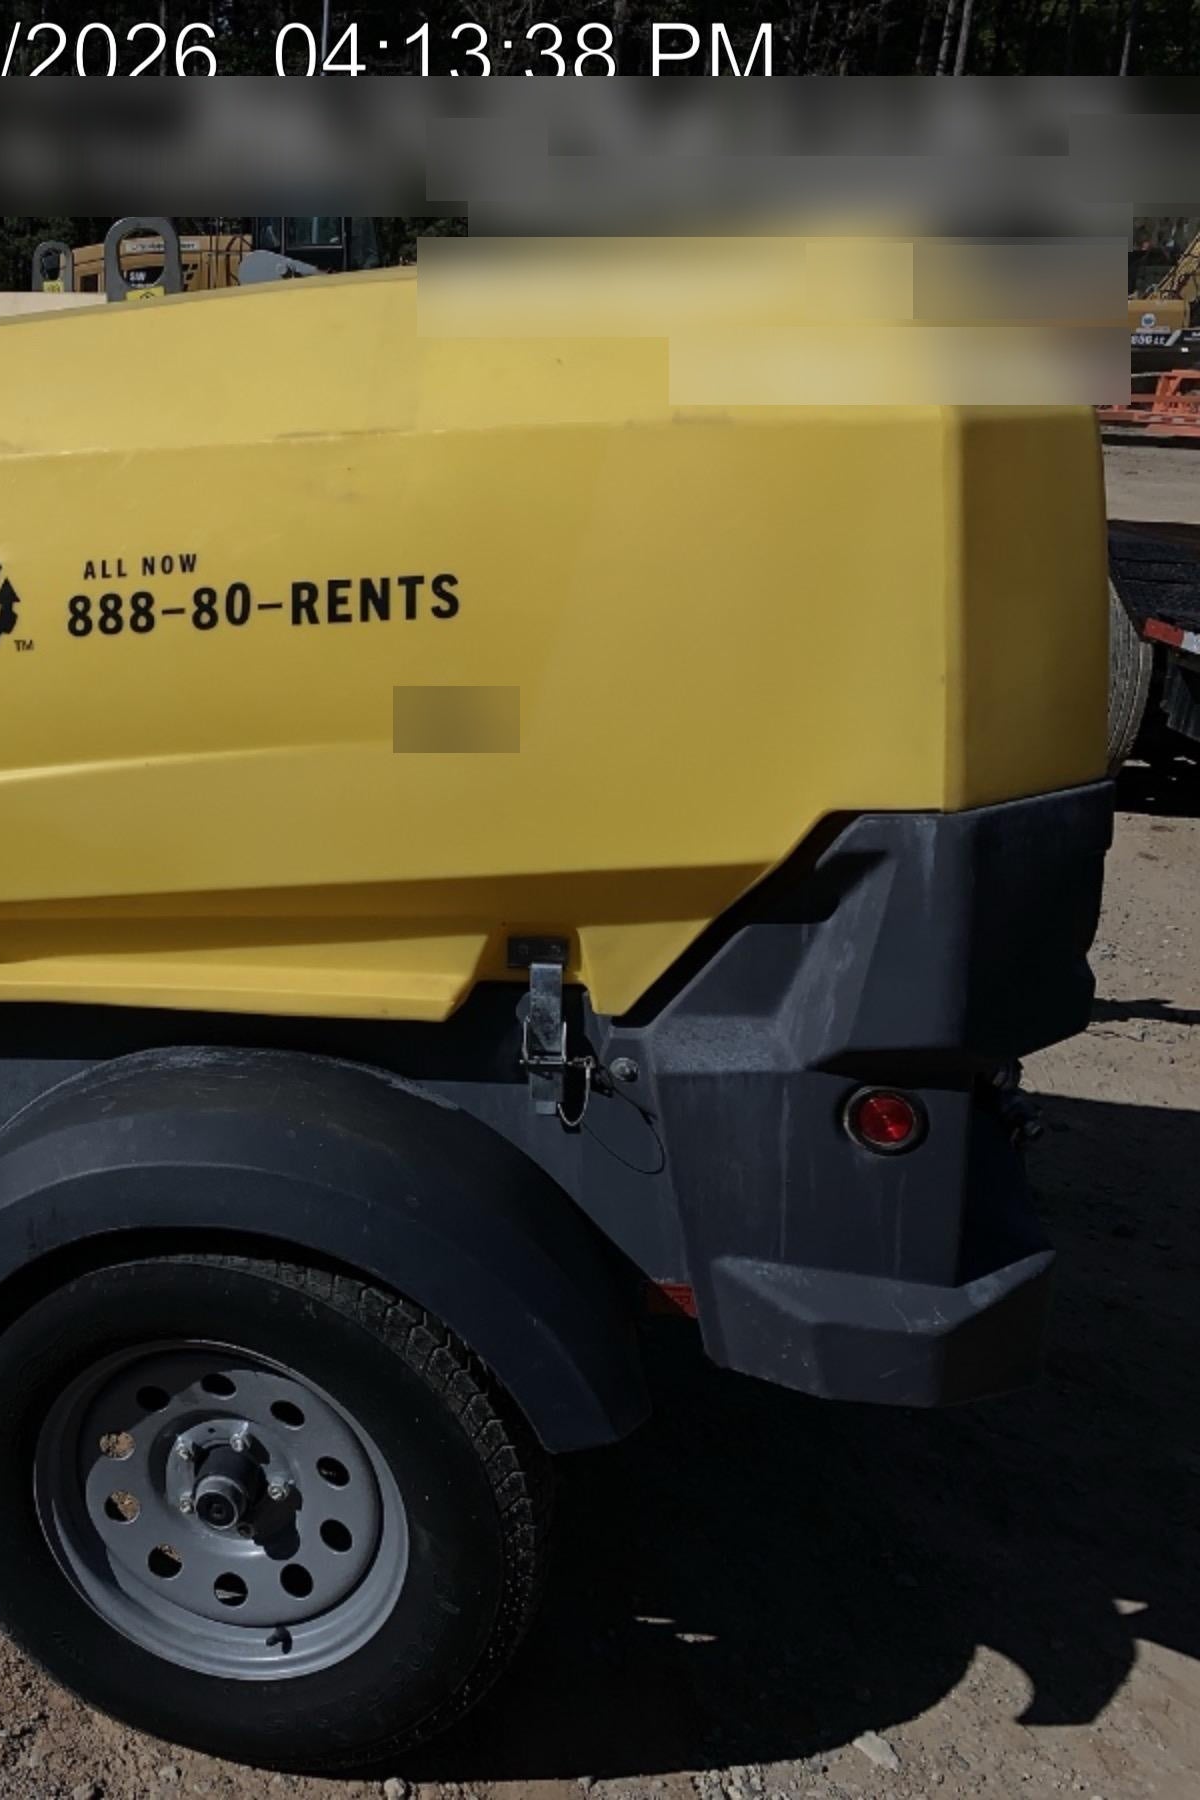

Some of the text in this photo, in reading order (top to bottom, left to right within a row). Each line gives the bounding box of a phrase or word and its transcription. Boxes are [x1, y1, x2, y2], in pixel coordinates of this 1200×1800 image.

[83, 553, 198, 580] ALL NOW
[67, 573, 460, 637] 888-80-RENTS
